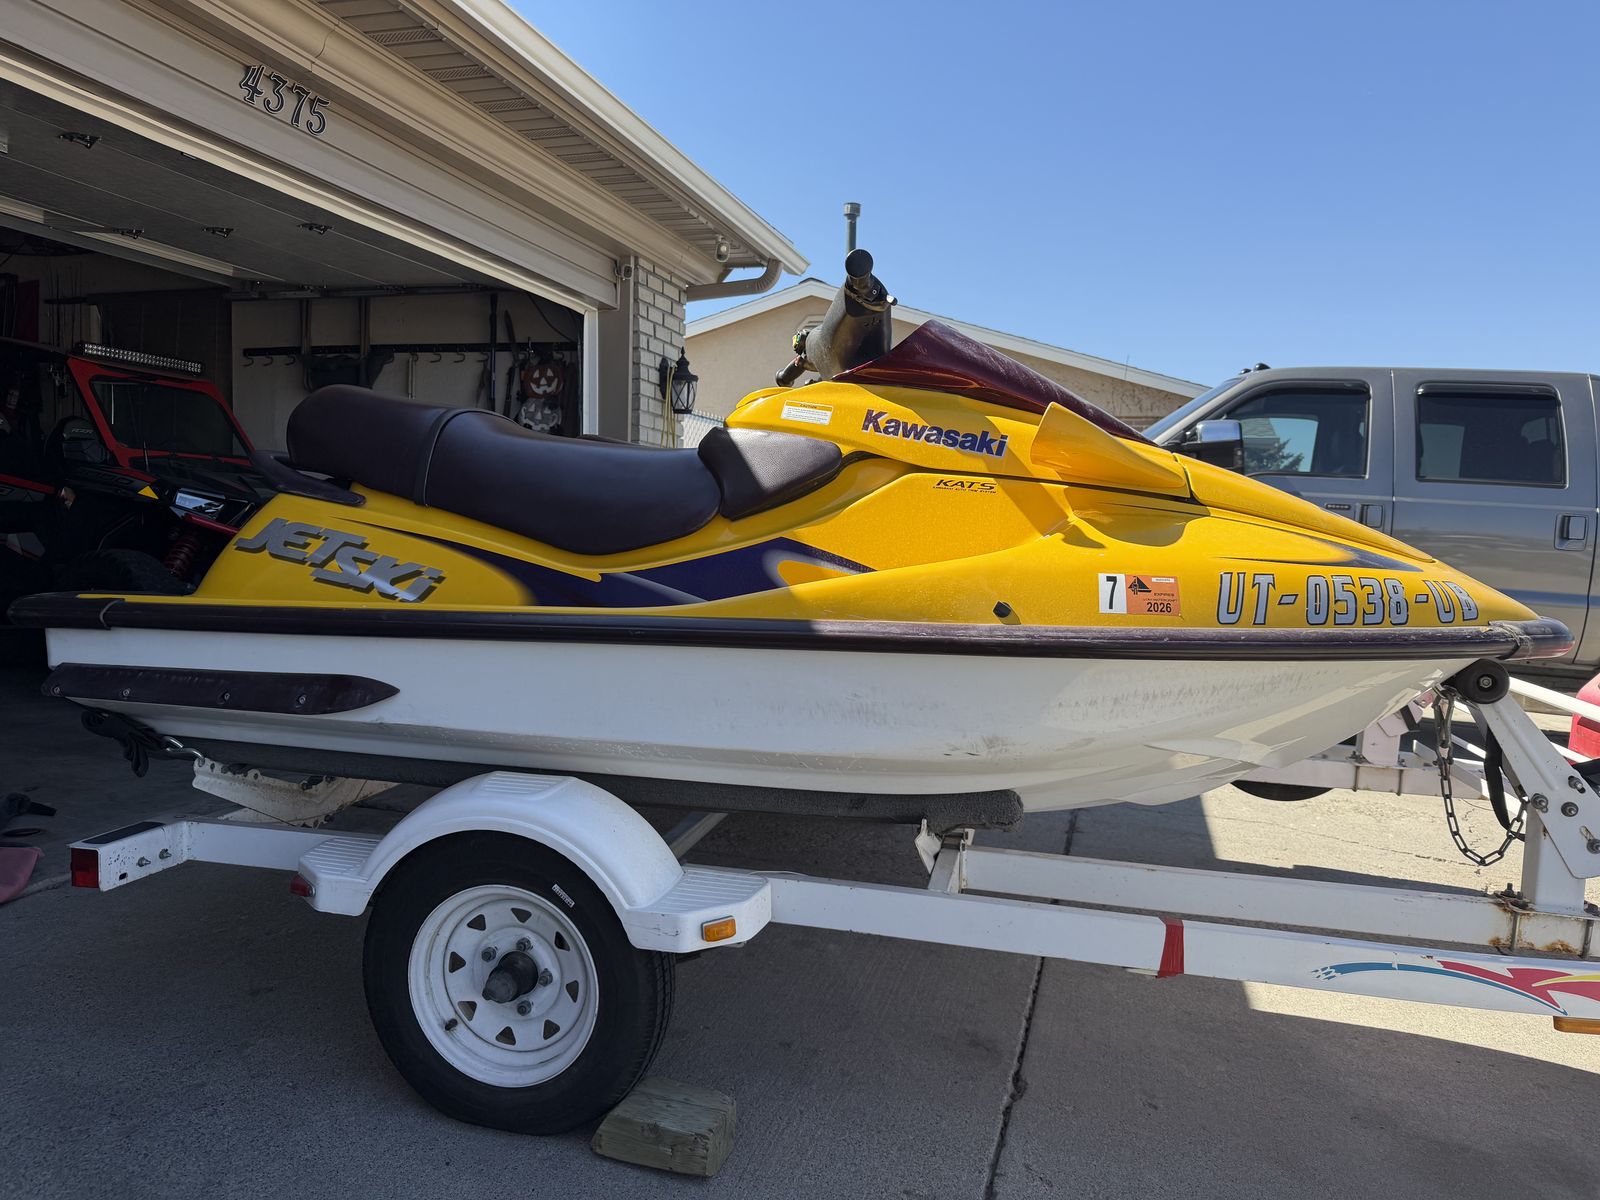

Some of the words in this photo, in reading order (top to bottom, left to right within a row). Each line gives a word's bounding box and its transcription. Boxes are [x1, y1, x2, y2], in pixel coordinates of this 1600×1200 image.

[239, 65, 331, 136] 4375
[861, 408, 1009, 458] Kawasaki
[936, 479, 998, 490] KATS
[1105, 575, 1118, 610] 7
[1146, 602, 1172, 613] 2026
